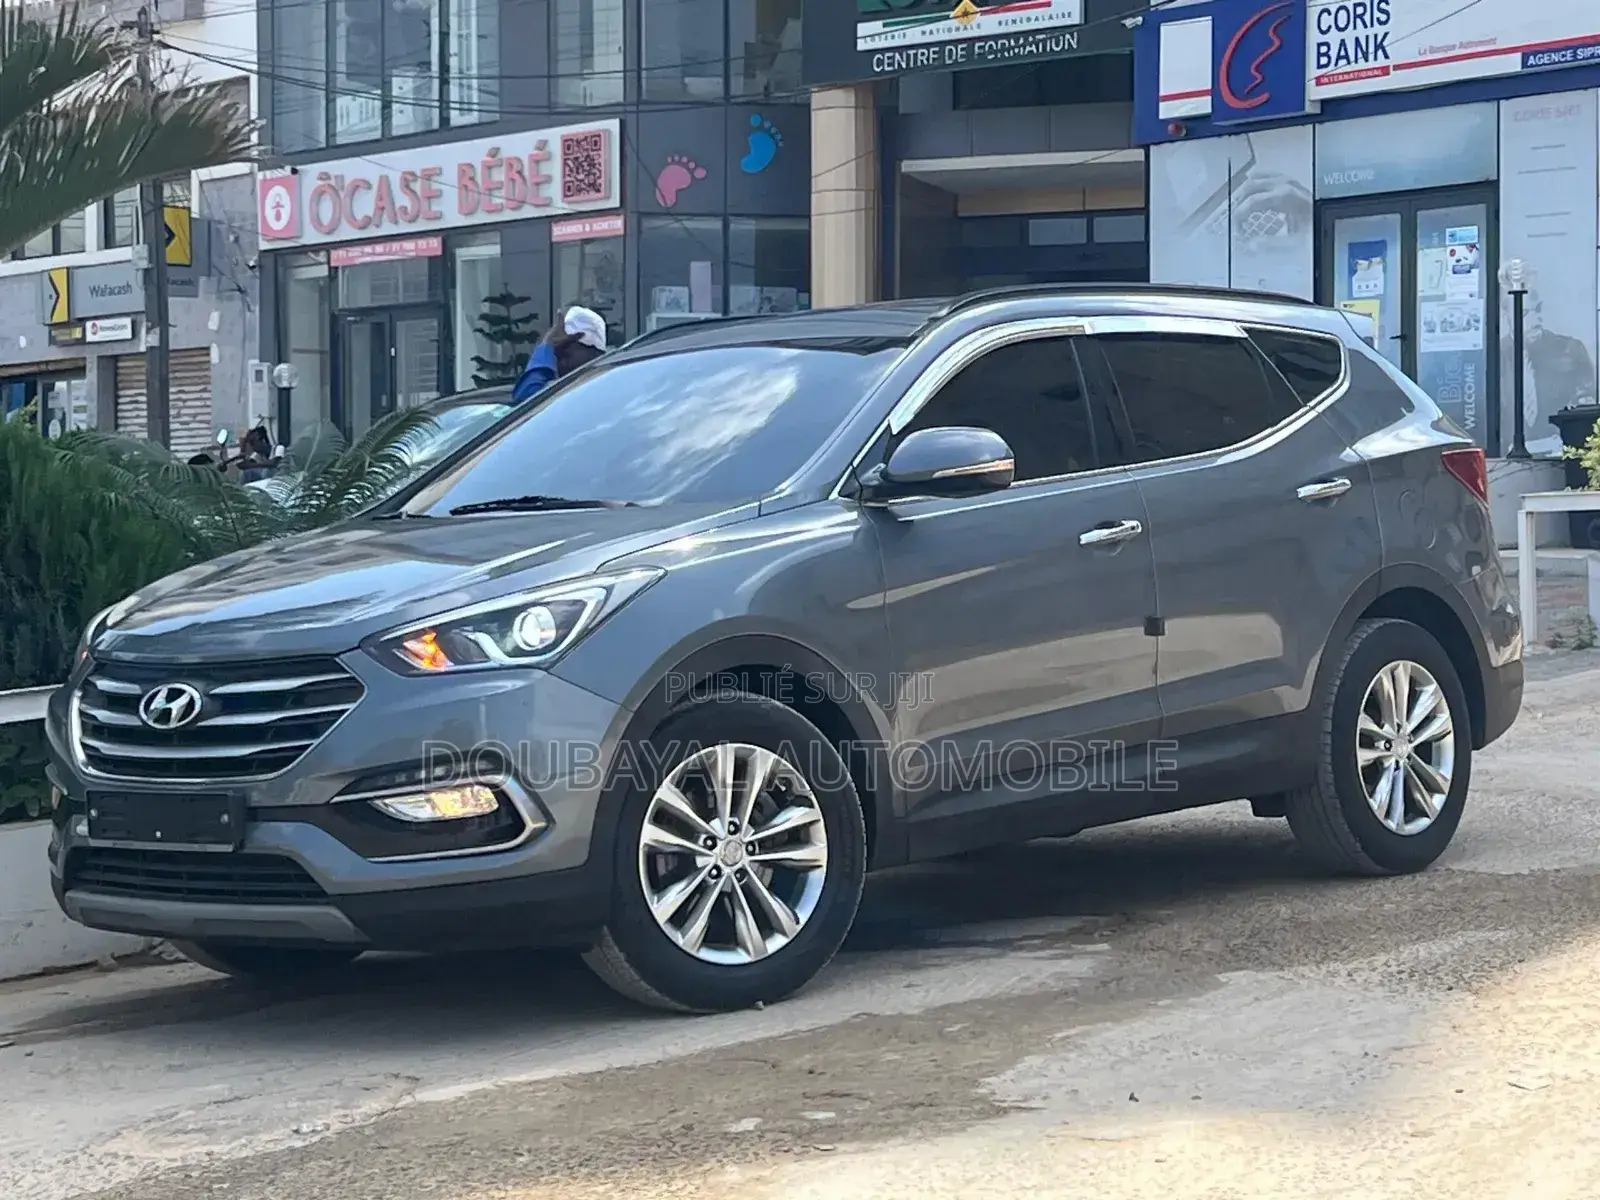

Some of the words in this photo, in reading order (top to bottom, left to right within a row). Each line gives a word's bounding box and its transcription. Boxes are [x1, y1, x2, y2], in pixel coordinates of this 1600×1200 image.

[1317, 0, 1390, 35] CORIS
[872, 47, 939, 72] CENTRE
[945, 44, 967, 64] DE
[974, 32, 1078, 60] FORMATION
[1316, 31, 1390, 70] BANK
[1527, 49, 1574, 66] AGENCE
[1320, 68, 1383, 83] INTERNATIONAL
[457, 139, 554, 216] BÉBÉ
[88, 281, 133, 299] Wafacash
[1463, 363, 1476, 430] WELCOME
